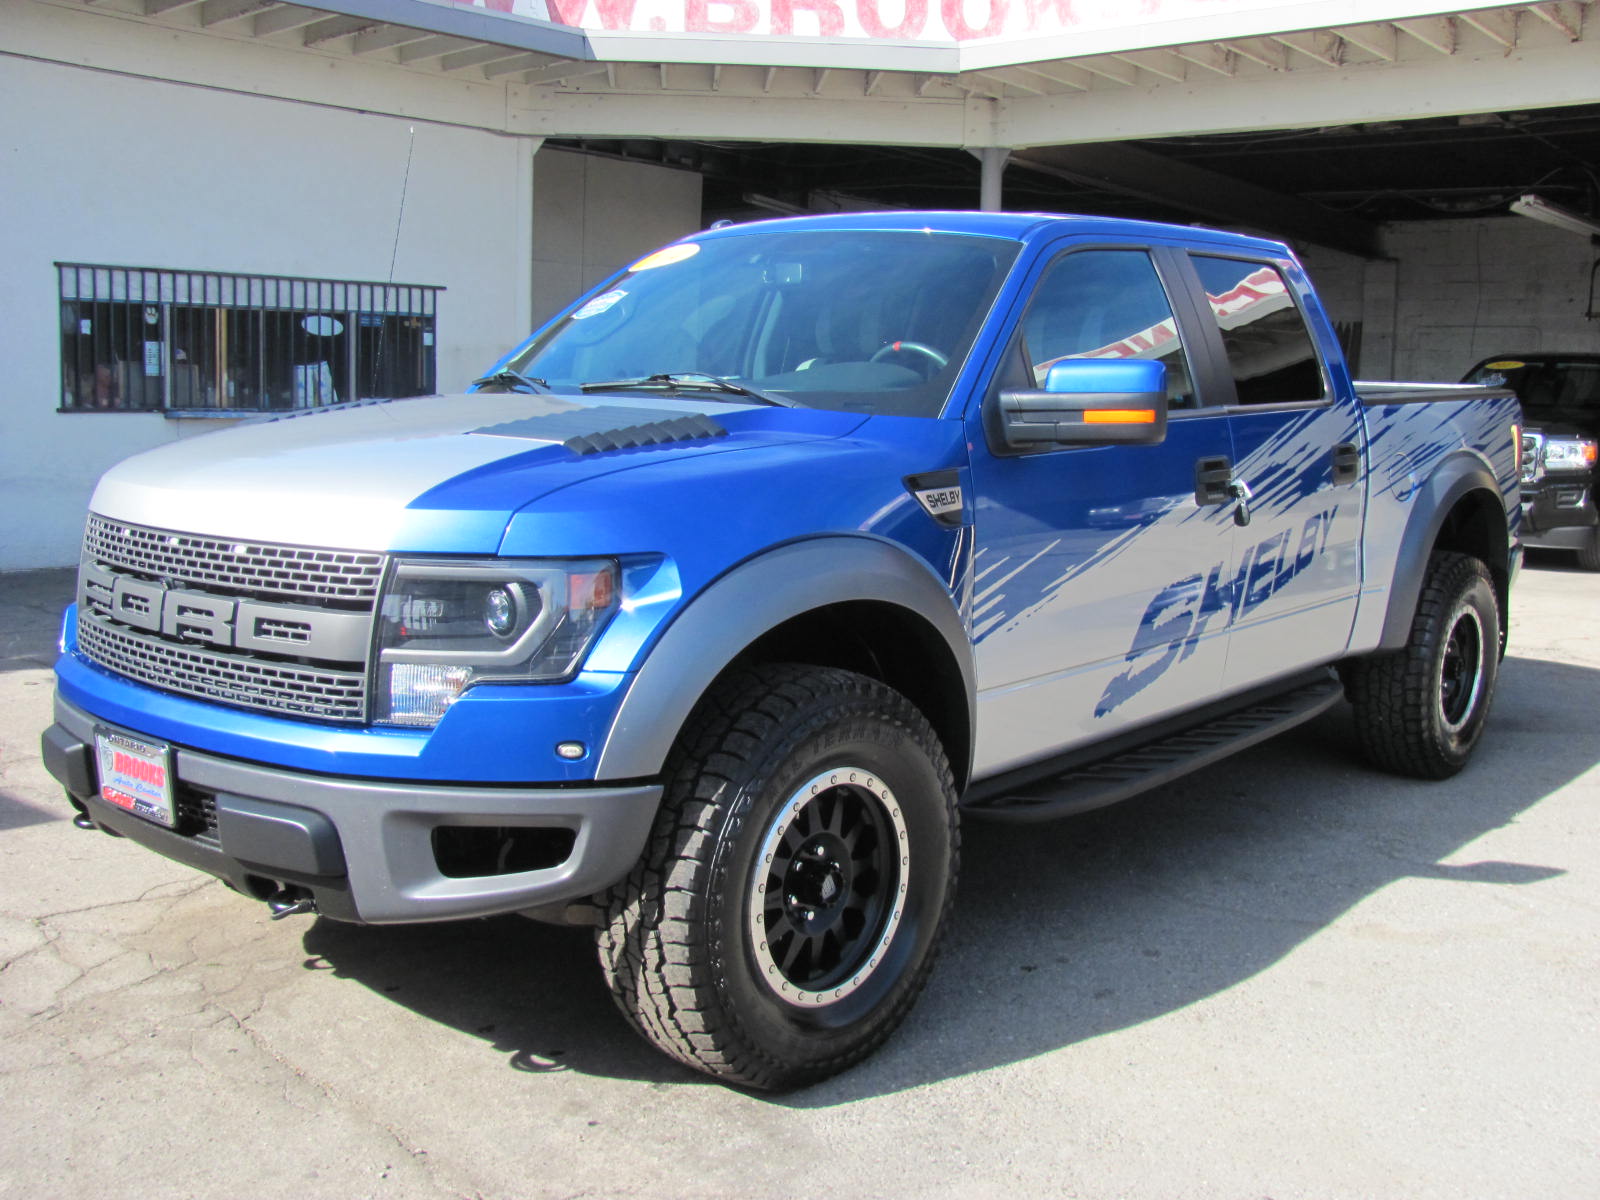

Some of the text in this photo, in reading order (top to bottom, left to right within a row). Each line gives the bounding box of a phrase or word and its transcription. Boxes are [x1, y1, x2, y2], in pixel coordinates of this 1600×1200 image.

[925, 490, 960, 508] SHELBY
[79, 562, 372, 662] FORD
[1094, 504, 1338, 719] SHELBY
[113, 751, 165, 788] BROOKS
